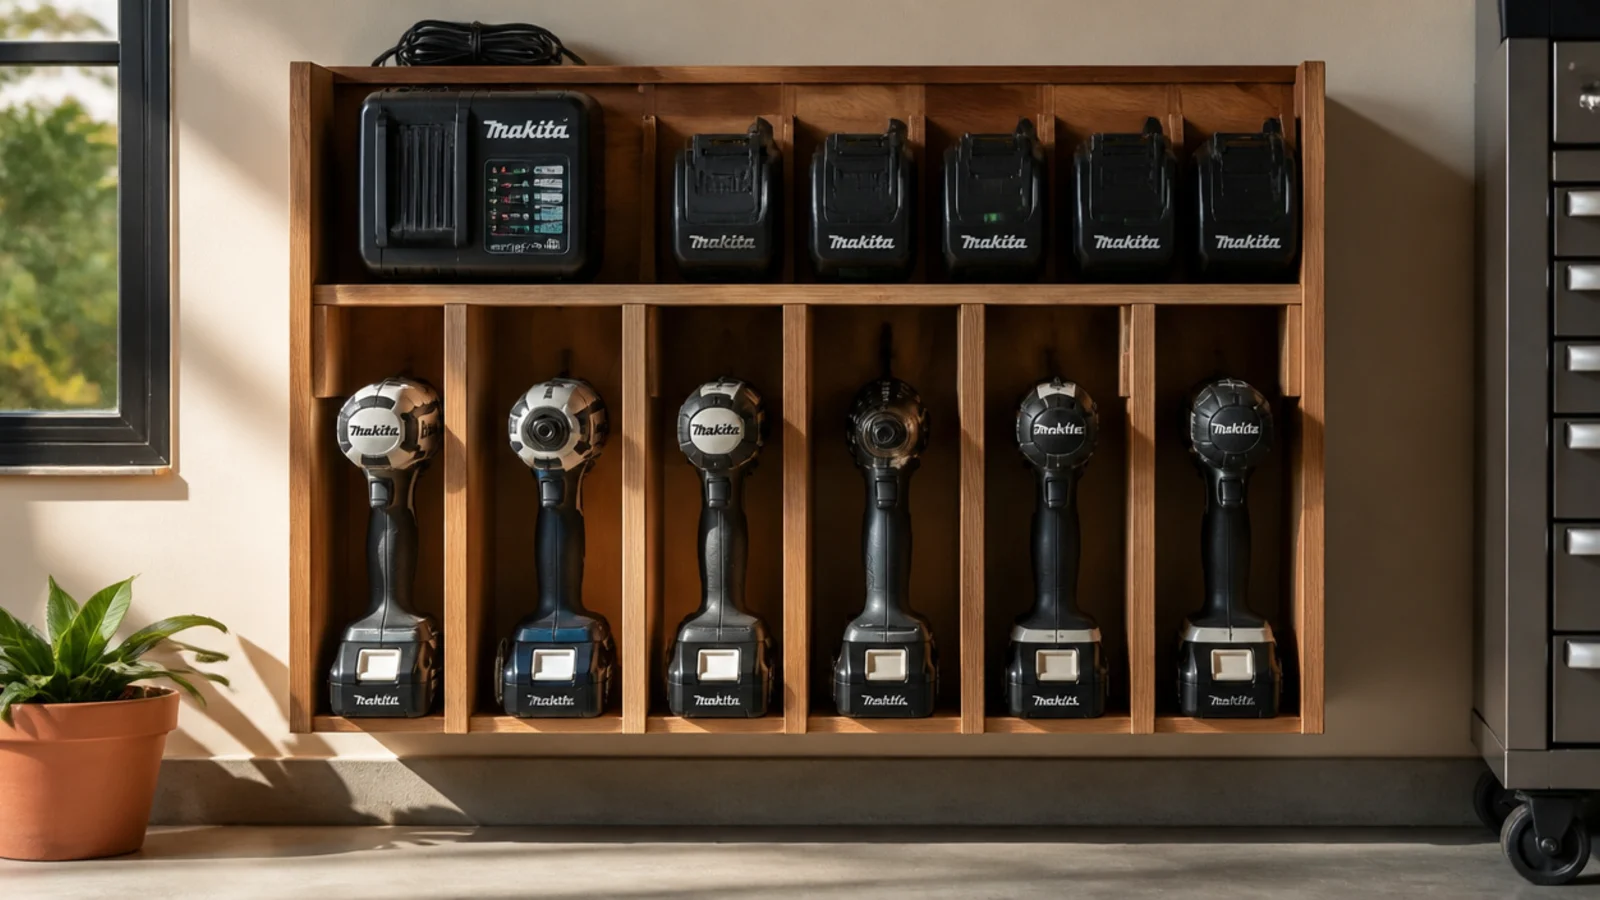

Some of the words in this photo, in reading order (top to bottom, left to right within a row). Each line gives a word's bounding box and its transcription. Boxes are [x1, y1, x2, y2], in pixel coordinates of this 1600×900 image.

[484, 119, 570, 138] Makita
[689, 234, 756, 249] Makita
[828, 234, 896, 249] Makita
[960, 234, 1028, 249] Makita
[1093, 234, 1161, 249] Makita
[1214, 234, 1282, 249] Makita
[350, 425, 400, 437] Makita
[692, 423, 741, 436] Makita
